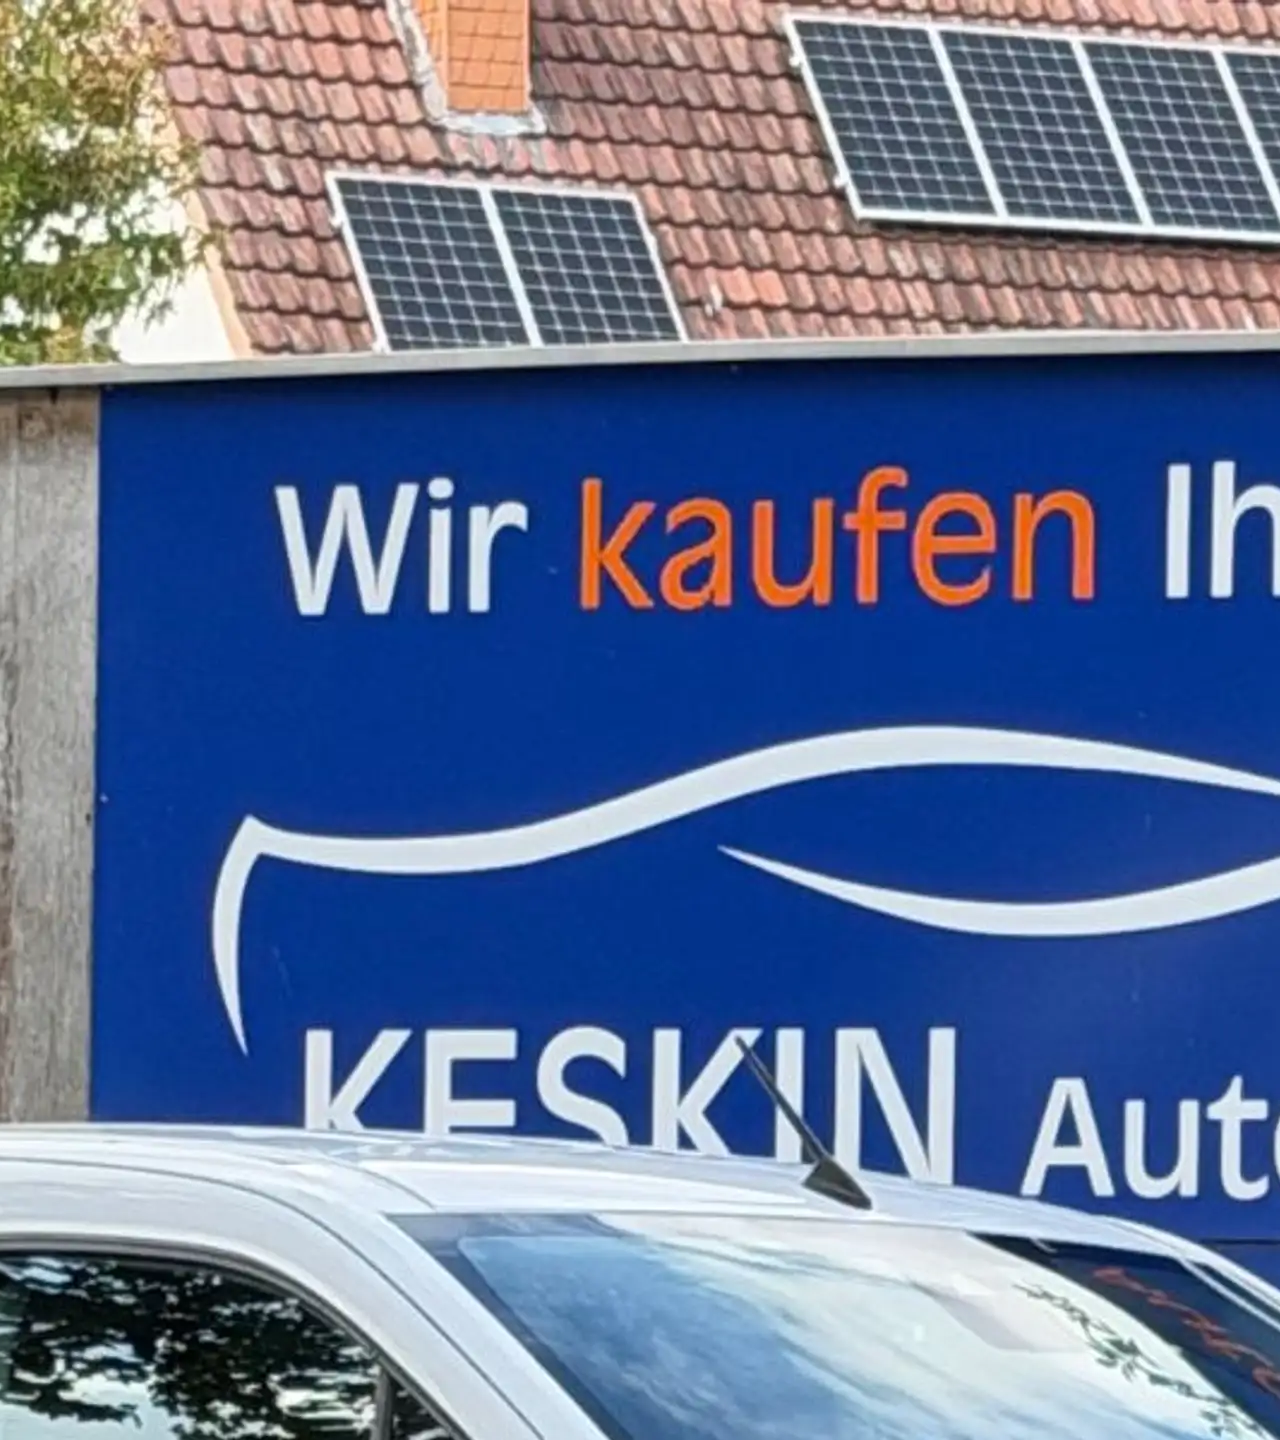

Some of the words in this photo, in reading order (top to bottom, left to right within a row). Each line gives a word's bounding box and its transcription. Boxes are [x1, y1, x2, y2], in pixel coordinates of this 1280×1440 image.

[274, 476, 529, 616] Wir
[580, 467, 1095, 611] kaufen
[304, 1025, 957, 1184] KESKIN
